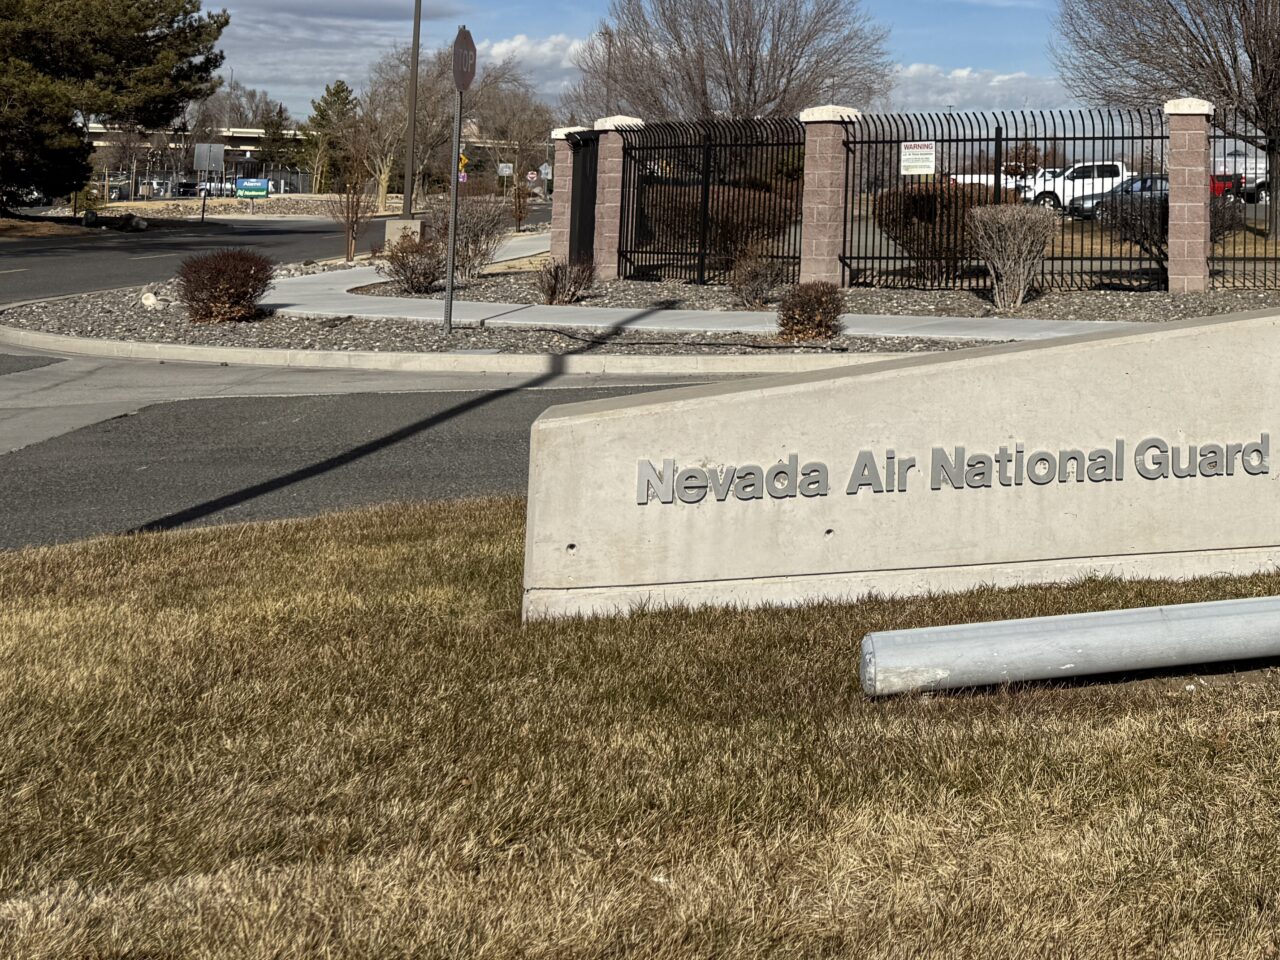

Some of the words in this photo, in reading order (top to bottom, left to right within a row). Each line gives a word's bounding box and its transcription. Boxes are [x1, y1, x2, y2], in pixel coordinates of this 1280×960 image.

[636, 453, 828, 506] Nevada
[845, 449, 917, 496] Air
[930, 438, 1124, 490] National
[1134, 433, 1270, 480] Guard
